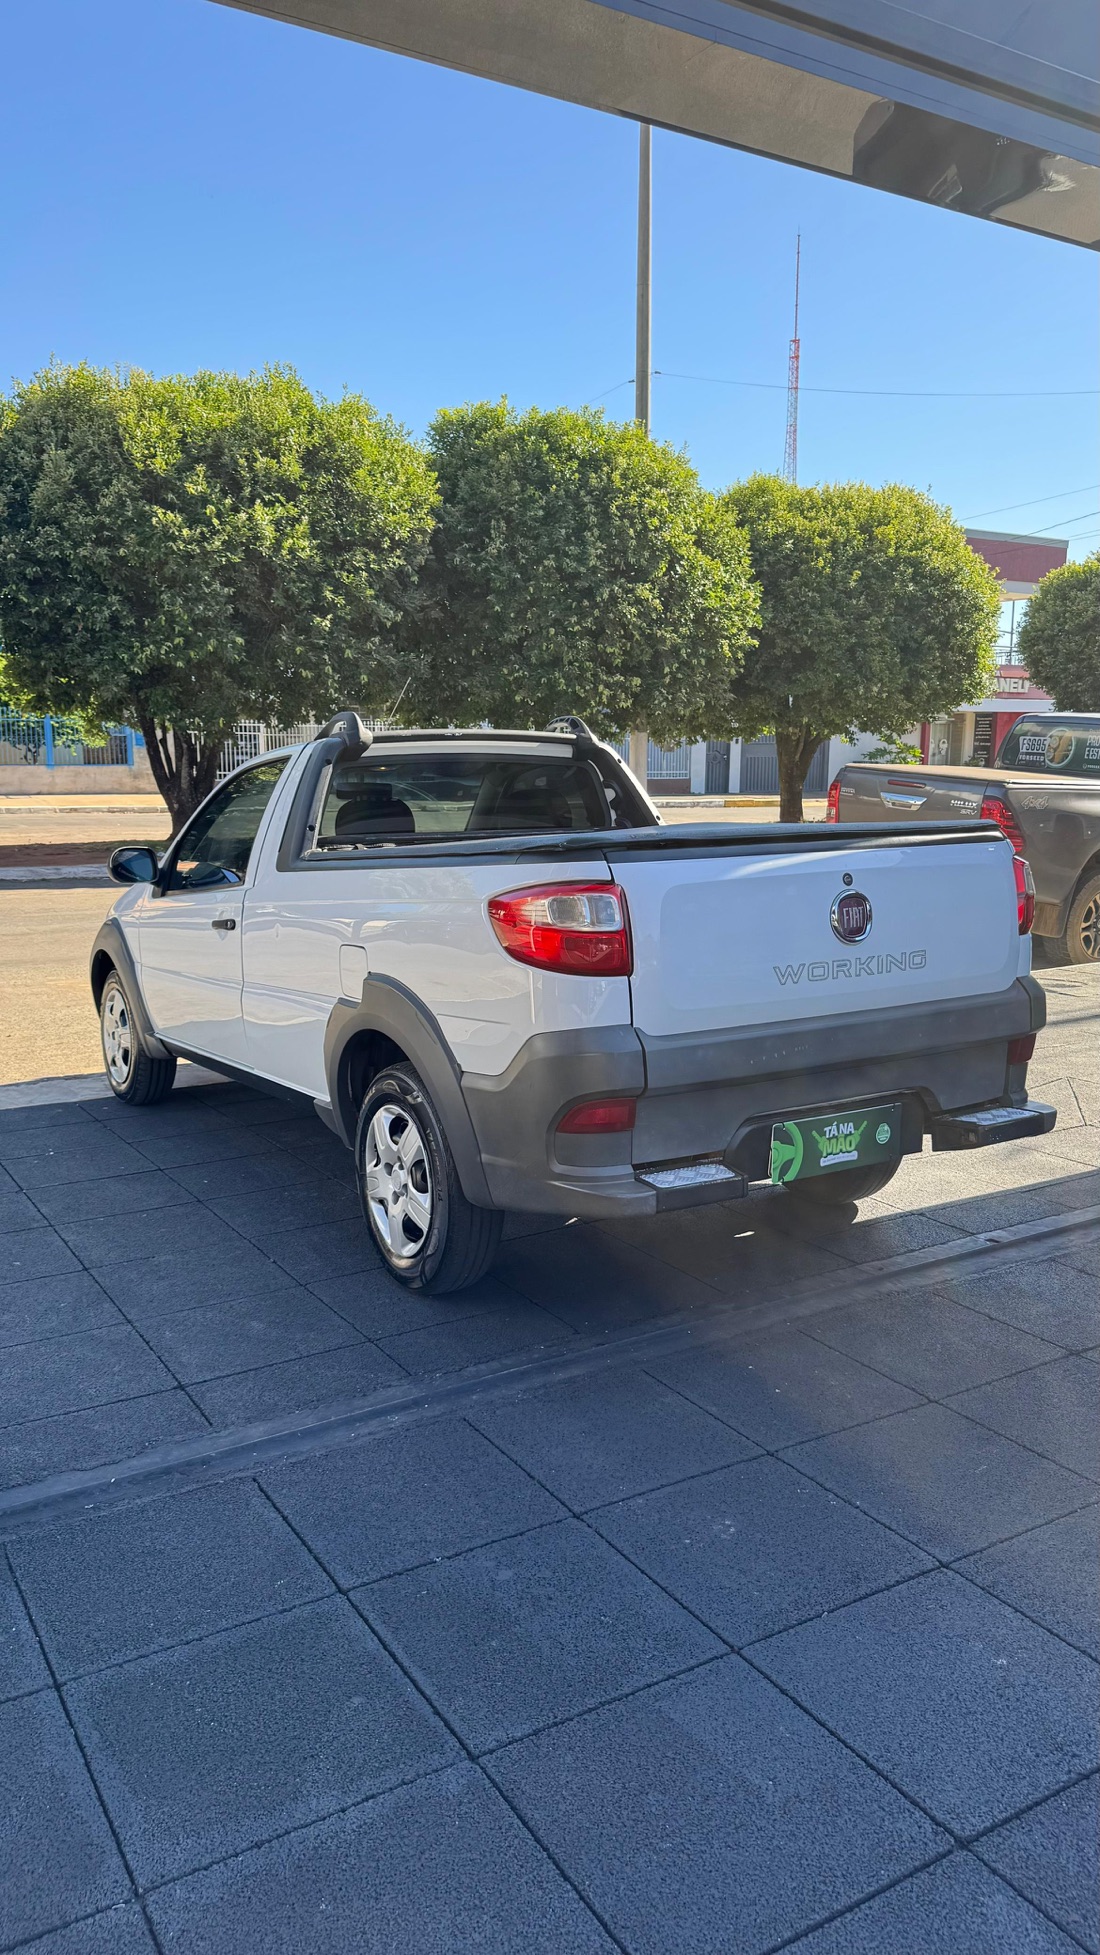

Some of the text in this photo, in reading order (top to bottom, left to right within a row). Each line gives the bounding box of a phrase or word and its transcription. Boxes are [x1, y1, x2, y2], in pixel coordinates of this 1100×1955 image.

[842, 905, 865, 929] FIAT
[772, 949, 928, 986] WORKING
[823, 1120, 855, 1138] TÁ NA
[822, 1134, 856, 1158] MÃO
